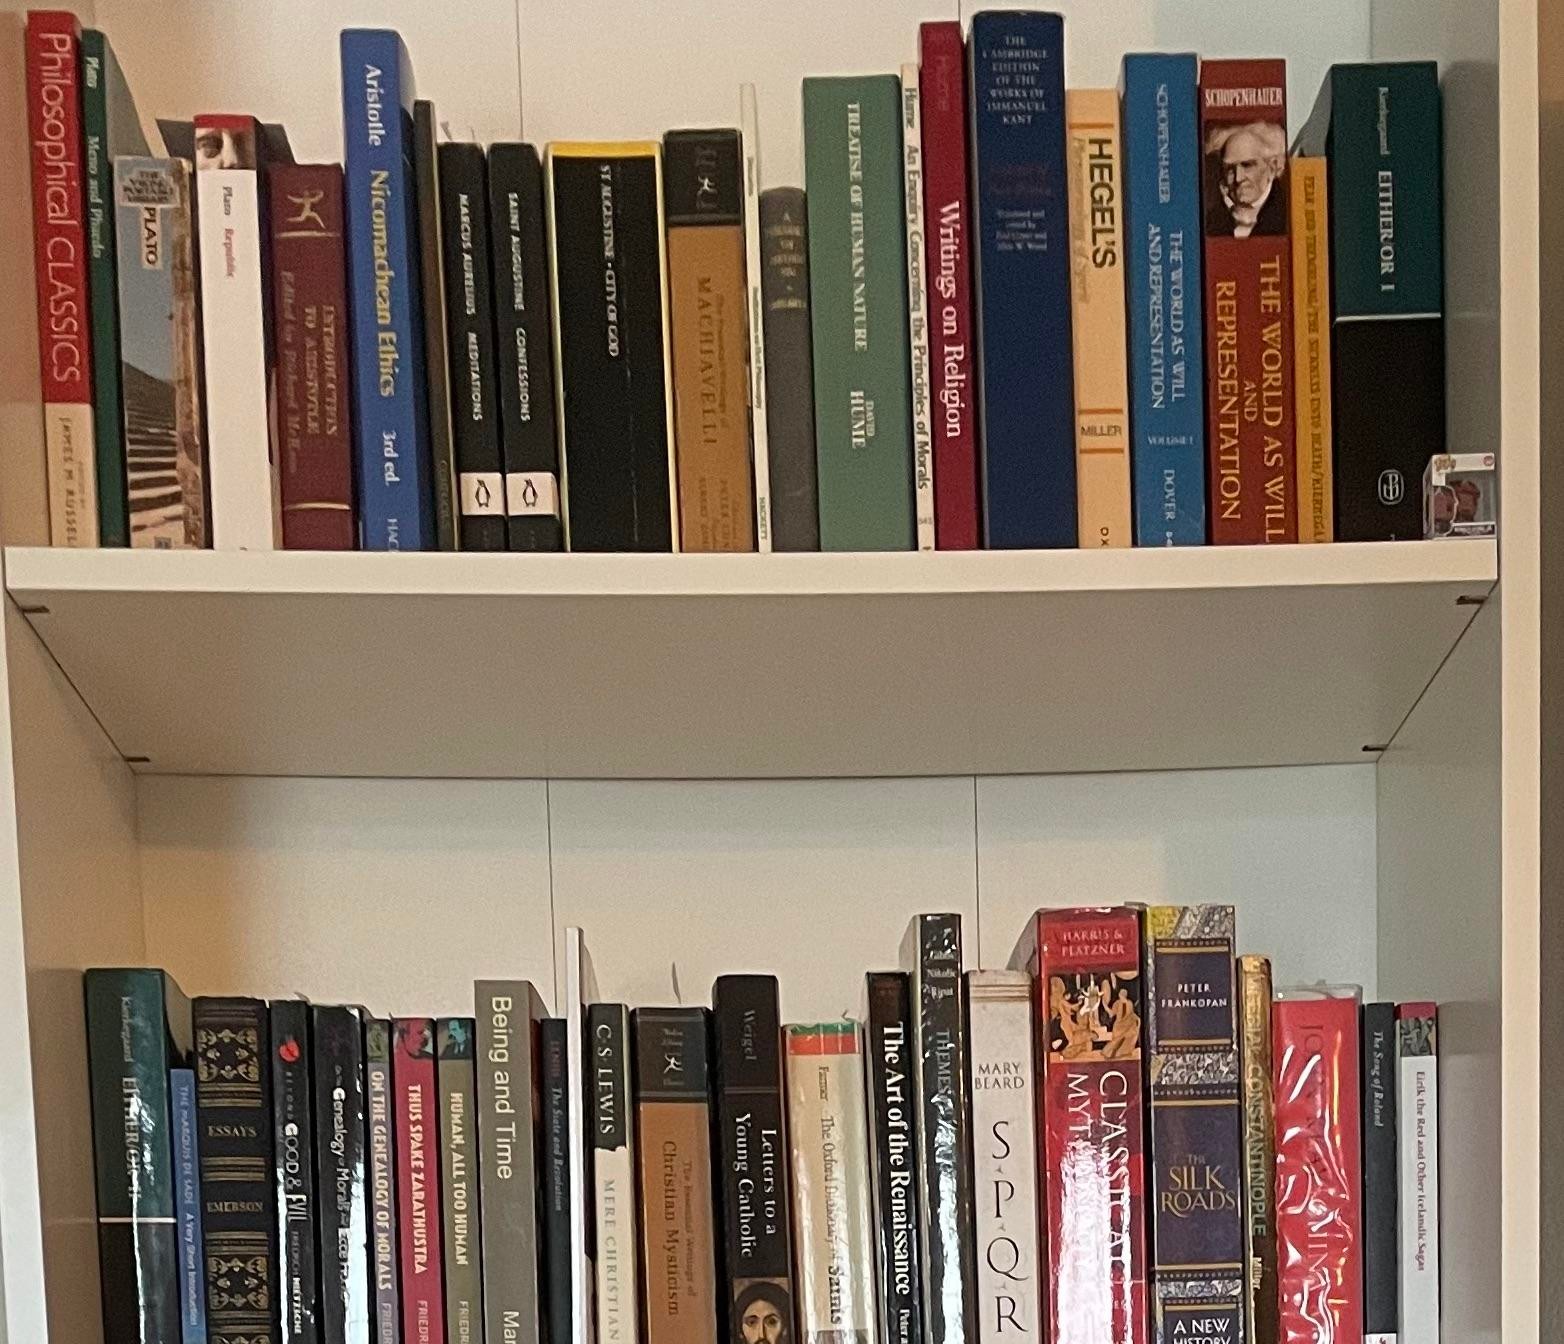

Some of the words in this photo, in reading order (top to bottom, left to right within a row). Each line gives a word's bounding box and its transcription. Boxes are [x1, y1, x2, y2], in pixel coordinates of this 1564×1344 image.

[33, 34, 78, 225] Philosophical
[365, 65, 384, 145] Aristotle
[847, 102, 861, 180] TREATISE
[459, 194, 471, 249] MARCUS
[508, 193, 520, 231] SAINT
[850, 185, 862, 207] OF
[143, 207, 159, 265] PLATO
[370, 170, 394, 324] Nicomachean
[851, 212, 864, 277] HUMAN
[937, 201, 961, 298] Writings
[462, 253, 475, 314] AURELIUS
[510, 235, 524, 311] AUGUSTINE
[1259, 255, 1280, 313] THE
[46, 237, 80, 382] CLASSICS
[853, 282, 867, 351] NATURE
[942, 306, 960, 335] on
[378, 331, 398, 396] Ethics
[467, 332, 482, 421] MEDITATIONS
[515, 328, 530, 421] CONFESSIONS
[698, 277, 717, 444] MACHIAVELLI
[1261, 320, 1282, 427] WORLD
[944, 344, 965, 437] Religion
[1216, 282, 1240, 519] REPRESENTATION
[1244, 380, 1258, 421] AND
[383, 430, 397, 456] 3rd
[1263, 435, 1282, 467] AS
[384, 463, 398, 486] ed.
[1265, 476, 1285, 543] WILL
[489, 996, 514, 1064] Being
[372, 1071, 385, 1090] ON
[494, 1071, 511, 1116] and
[975, 1077, 1024, 1089] BEARD
[978, 1063, 1021, 1074] MARY
[373, 1094, 386, 1121] THE
[408, 1084, 422, 1121] THUS
[450, 1093, 466, 1148] HUMAN,
[208, 1126, 257, 1137] ESSAYS
[410, 1124, 424, 1169] SPAKE
[495, 1122, 516, 1179] Time
[374, 1124, 389, 1207] GENEALOGY
[452, 1152, 465, 1179] ALL
[761, 1128, 777, 1193] Letters
[376, 1210, 390, 1228] OF
[412, 1172, 428, 1273] ZARATHUSTRA
[453, 1182, 466, 1210] TOO
[763, 1200, 777, 1216] to
[455, 1214, 468, 1265] HUMAN
[765, 1222, 776, 1234] a
[377, 1232, 392, 1290] MORALS
[1174, 1320, 1187, 1334] A
[1193, 1319, 1229, 1333] NEW
